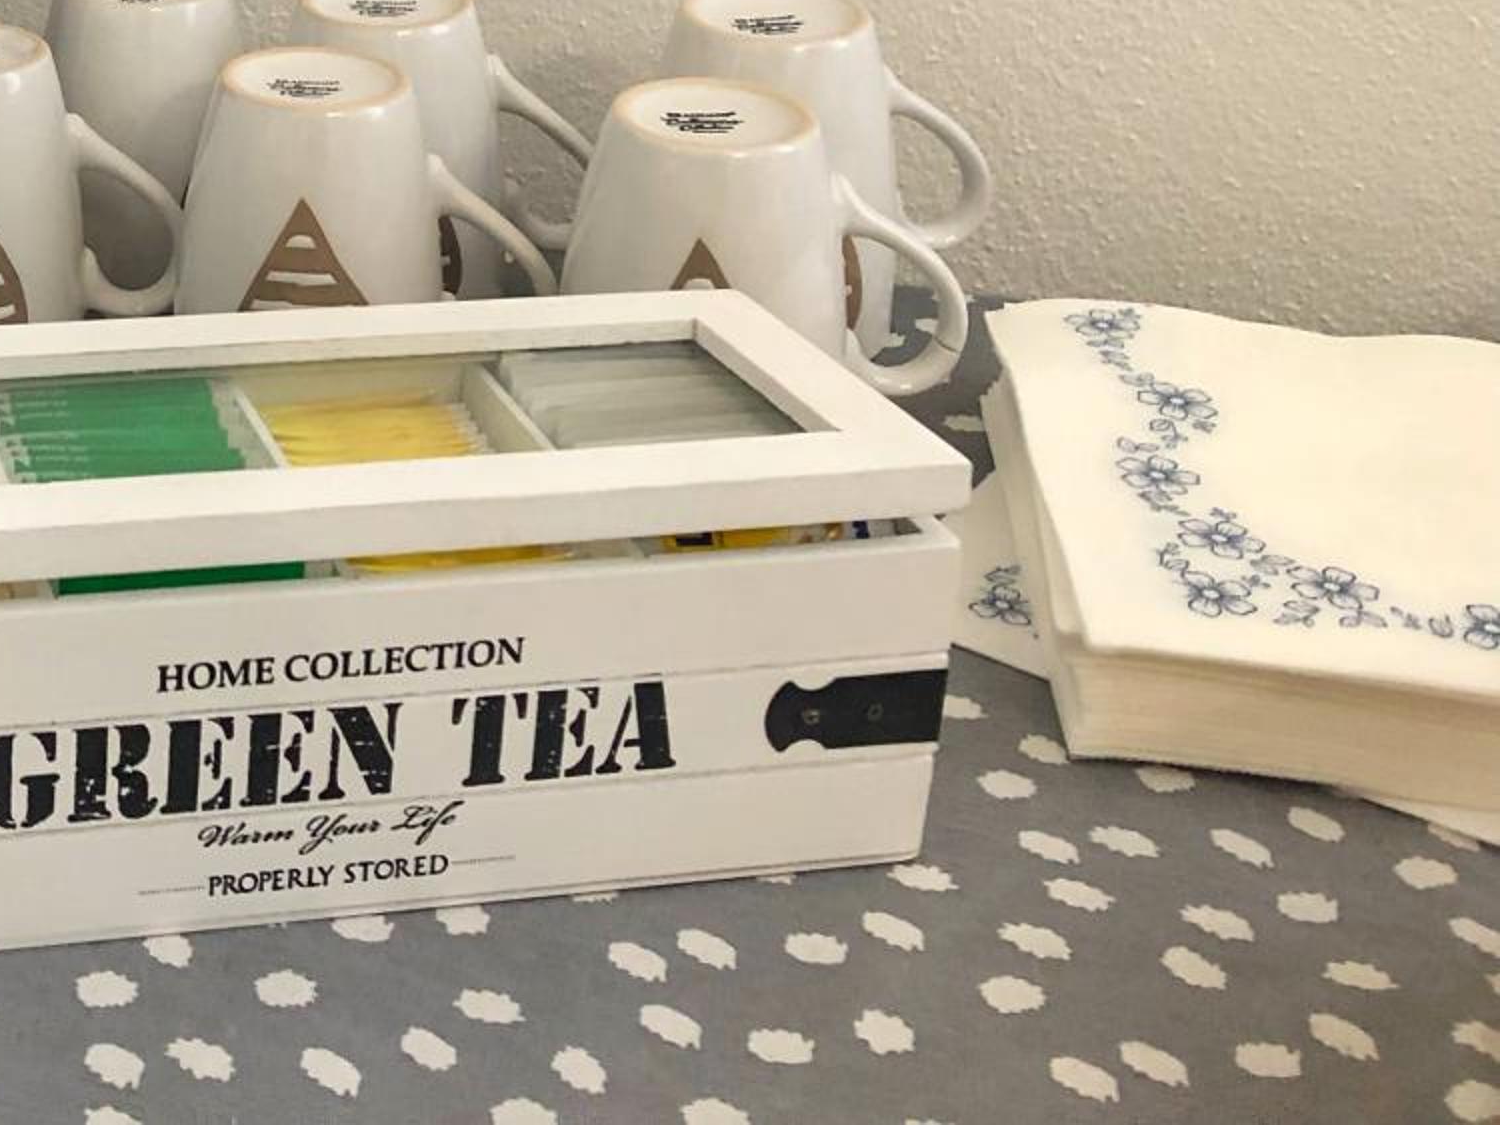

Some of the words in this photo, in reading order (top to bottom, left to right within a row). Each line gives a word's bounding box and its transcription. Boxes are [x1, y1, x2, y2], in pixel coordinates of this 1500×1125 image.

[156, 656, 275, 693] HOME
[284, 636, 525, 683] COLLECTION
[451, 679, 677, 788] TEA
[197, 822, 295, 848] Warm
[297, 811, 381, 856] Your
[389, 800, 466, 846] Life
[208, 864, 336, 897] PROPERLY
[343, 853, 449, 885] STORED
